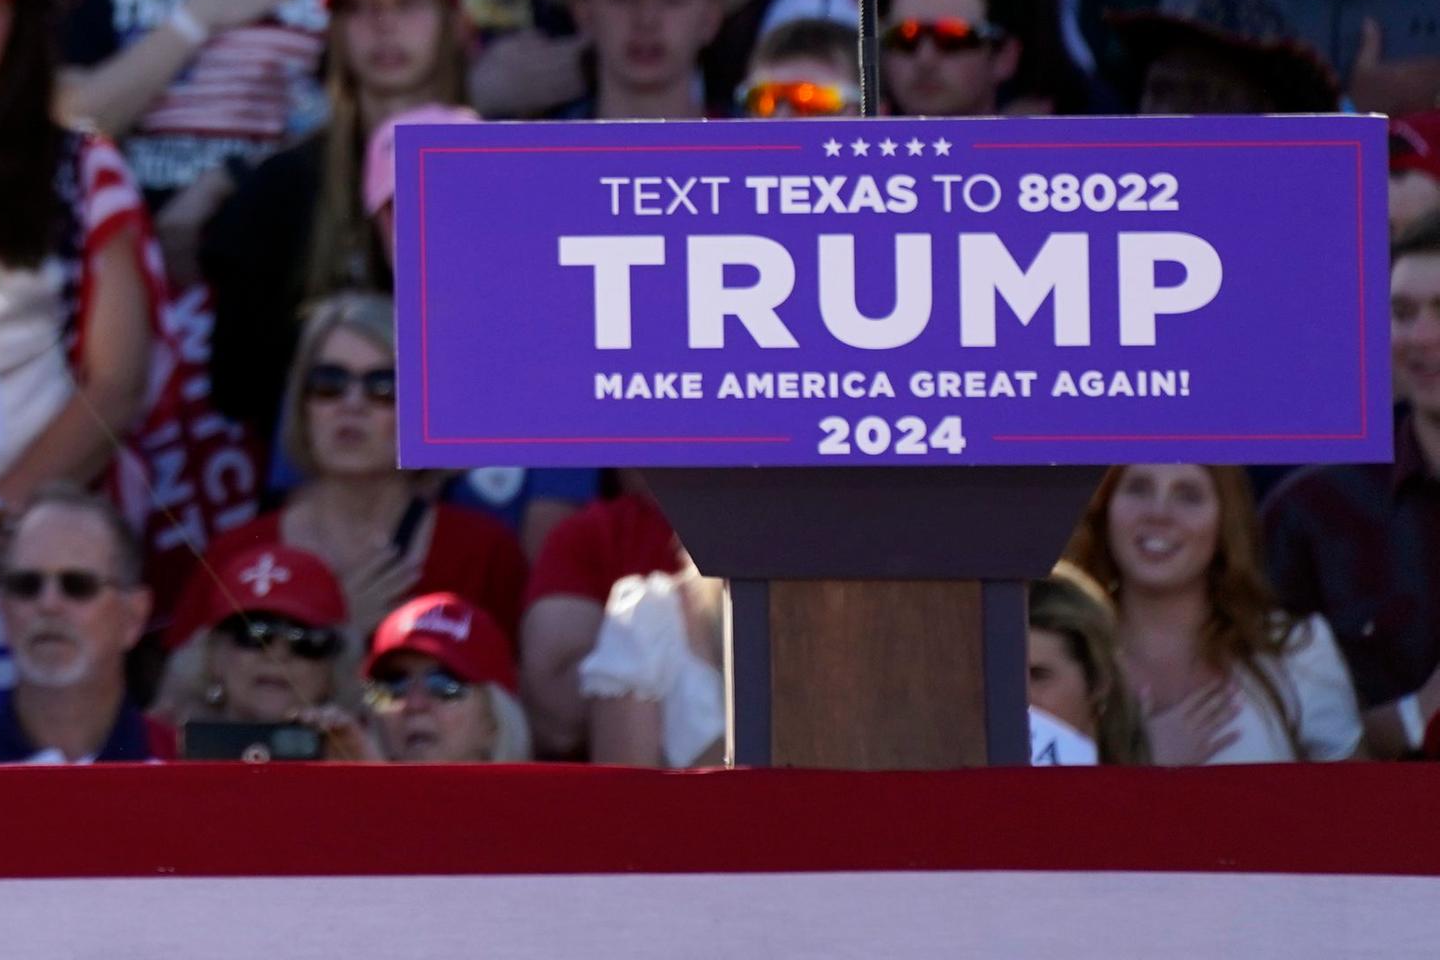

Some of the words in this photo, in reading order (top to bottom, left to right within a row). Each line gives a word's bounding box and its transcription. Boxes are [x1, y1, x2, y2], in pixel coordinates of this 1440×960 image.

[600, 176, 731, 216] TEXT
[746, 174, 918, 216] TEXAS
[932, 173, 1002, 214] TO
[1018, 172, 1179, 213] 88022
[558, 231, 1224, 350] TRUMP
[594, 372, 704, 400] MAKE
[717, 371, 896, 400] AMERICA
[909, 370, 1038, 399] GREAT
[1051, 370, 1191, 398] AGAIN!
[817, 415, 967, 456] 2024
